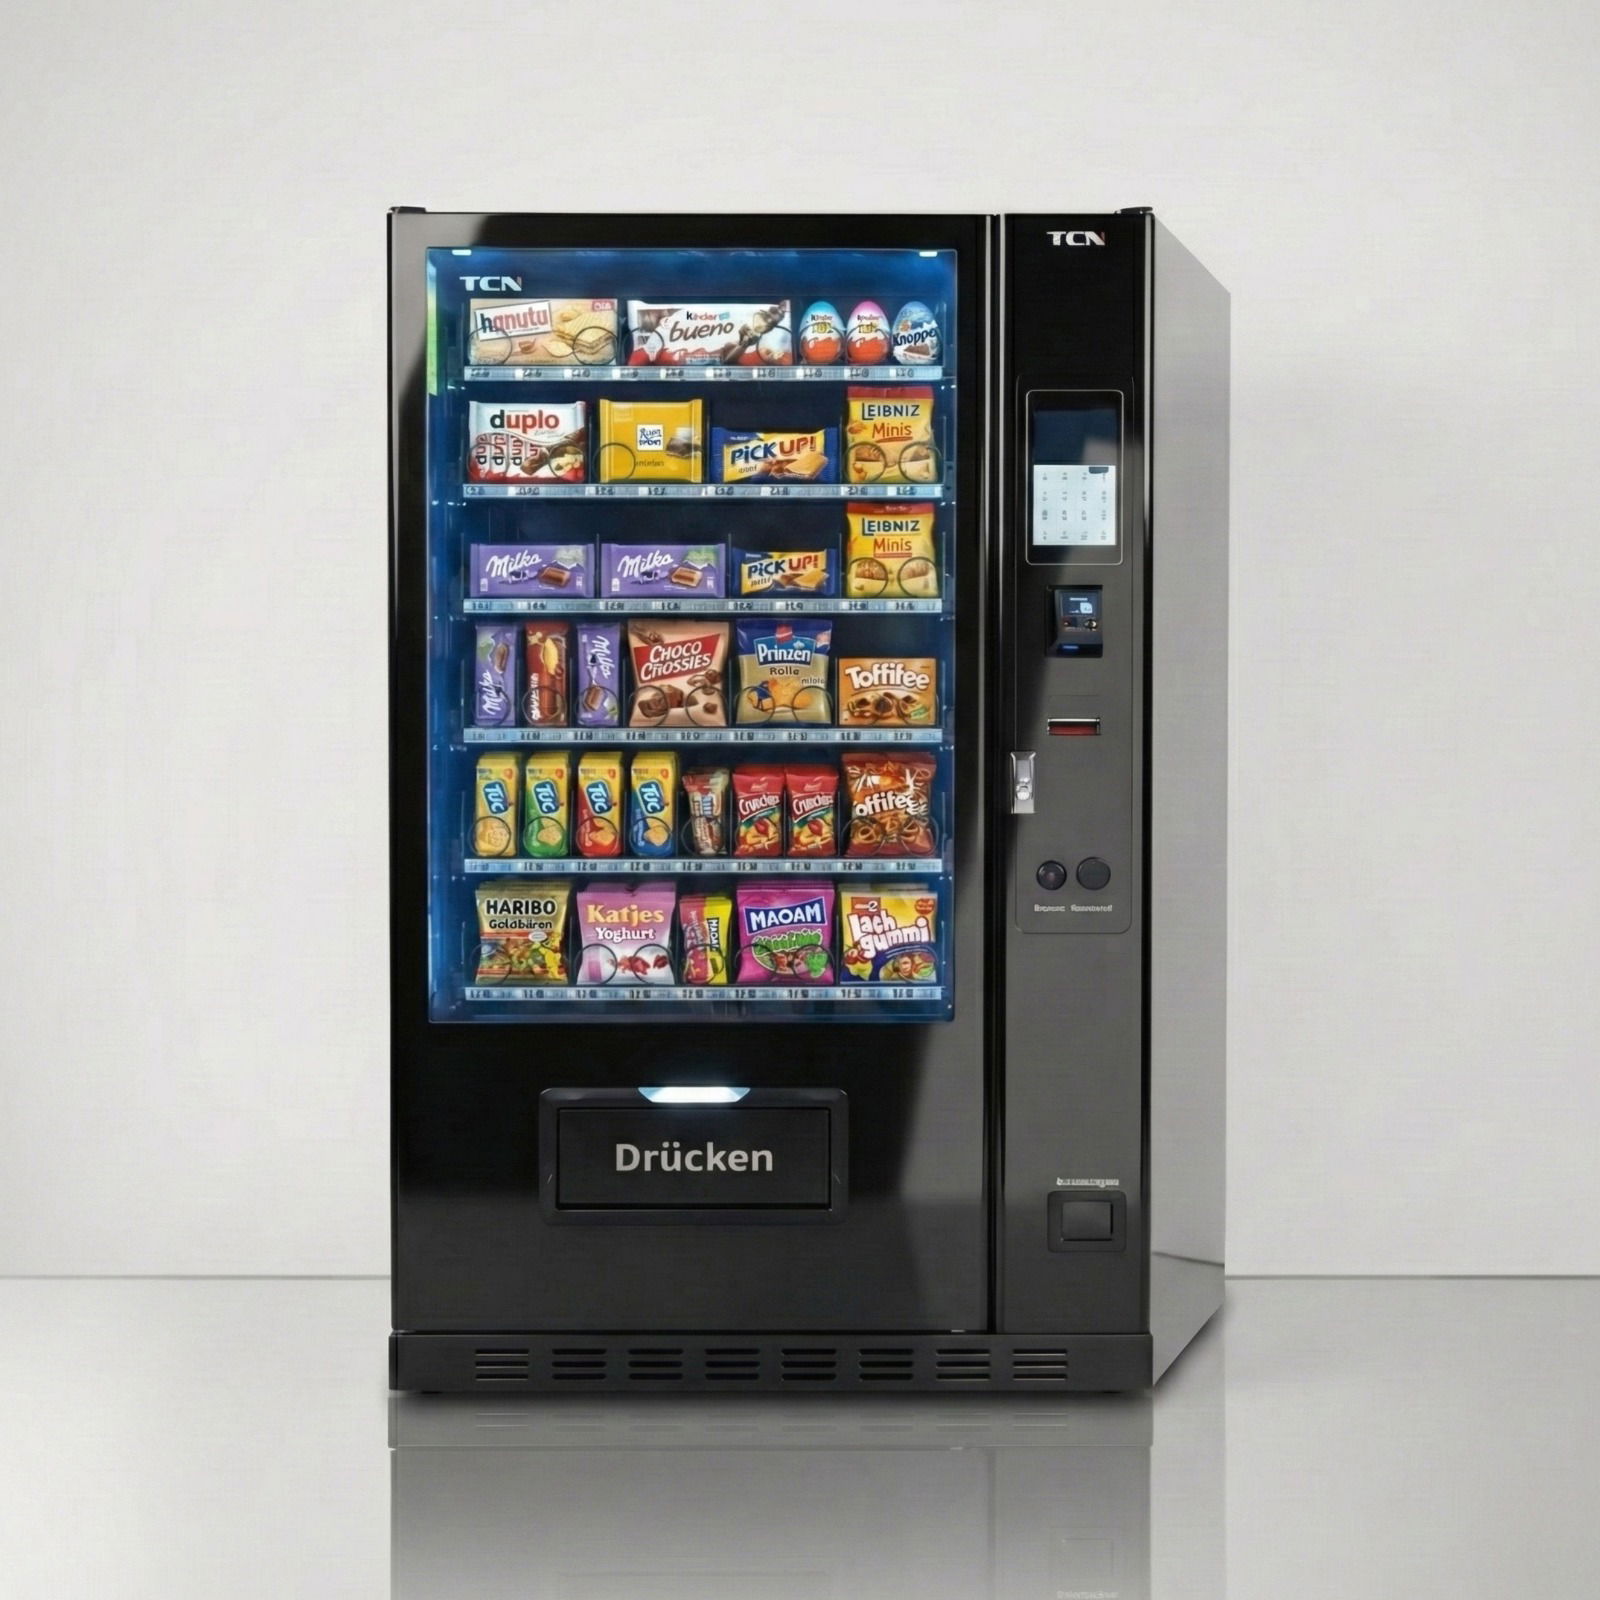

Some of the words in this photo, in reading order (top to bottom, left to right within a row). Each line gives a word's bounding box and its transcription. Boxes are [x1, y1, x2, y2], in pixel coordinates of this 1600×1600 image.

[1046, 231, 1106, 246] TCN
[459, 276, 522, 291] TCN
[669, 321, 735, 342] bueno
[490, 409, 560, 434] duplo
[861, 402, 921, 421] LEIBNIZ
[872, 422, 913, 438] Minis
[779, 437, 817, 456] UP!
[862, 518, 921, 536] LEIBNIZ
[873, 538, 913, 553] Minis
[486, 551, 542, 577] Milka
[617, 551, 673, 577] Milka
[788, 554, 819, 572] UP!
[649, 641, 702, 664] CHOCO
[757, 644, 811, 663] Prinzen
[769, 666, 800, 676] Rolle
[485, 783, 504, 813] TUC
[535, 783, 555, 813] TUC
[588, 783, 607, 813] TUC
[641, 783, 660, 813] TUC
[486, 899, 556, 915] HARIBO
[586, 904, 665, 925] Katjes
[749, 903, 822, 931] MAOAM
[595, 926, 656, 943] Yoghurt
[615, 1141, 774, 1172] Drücken
